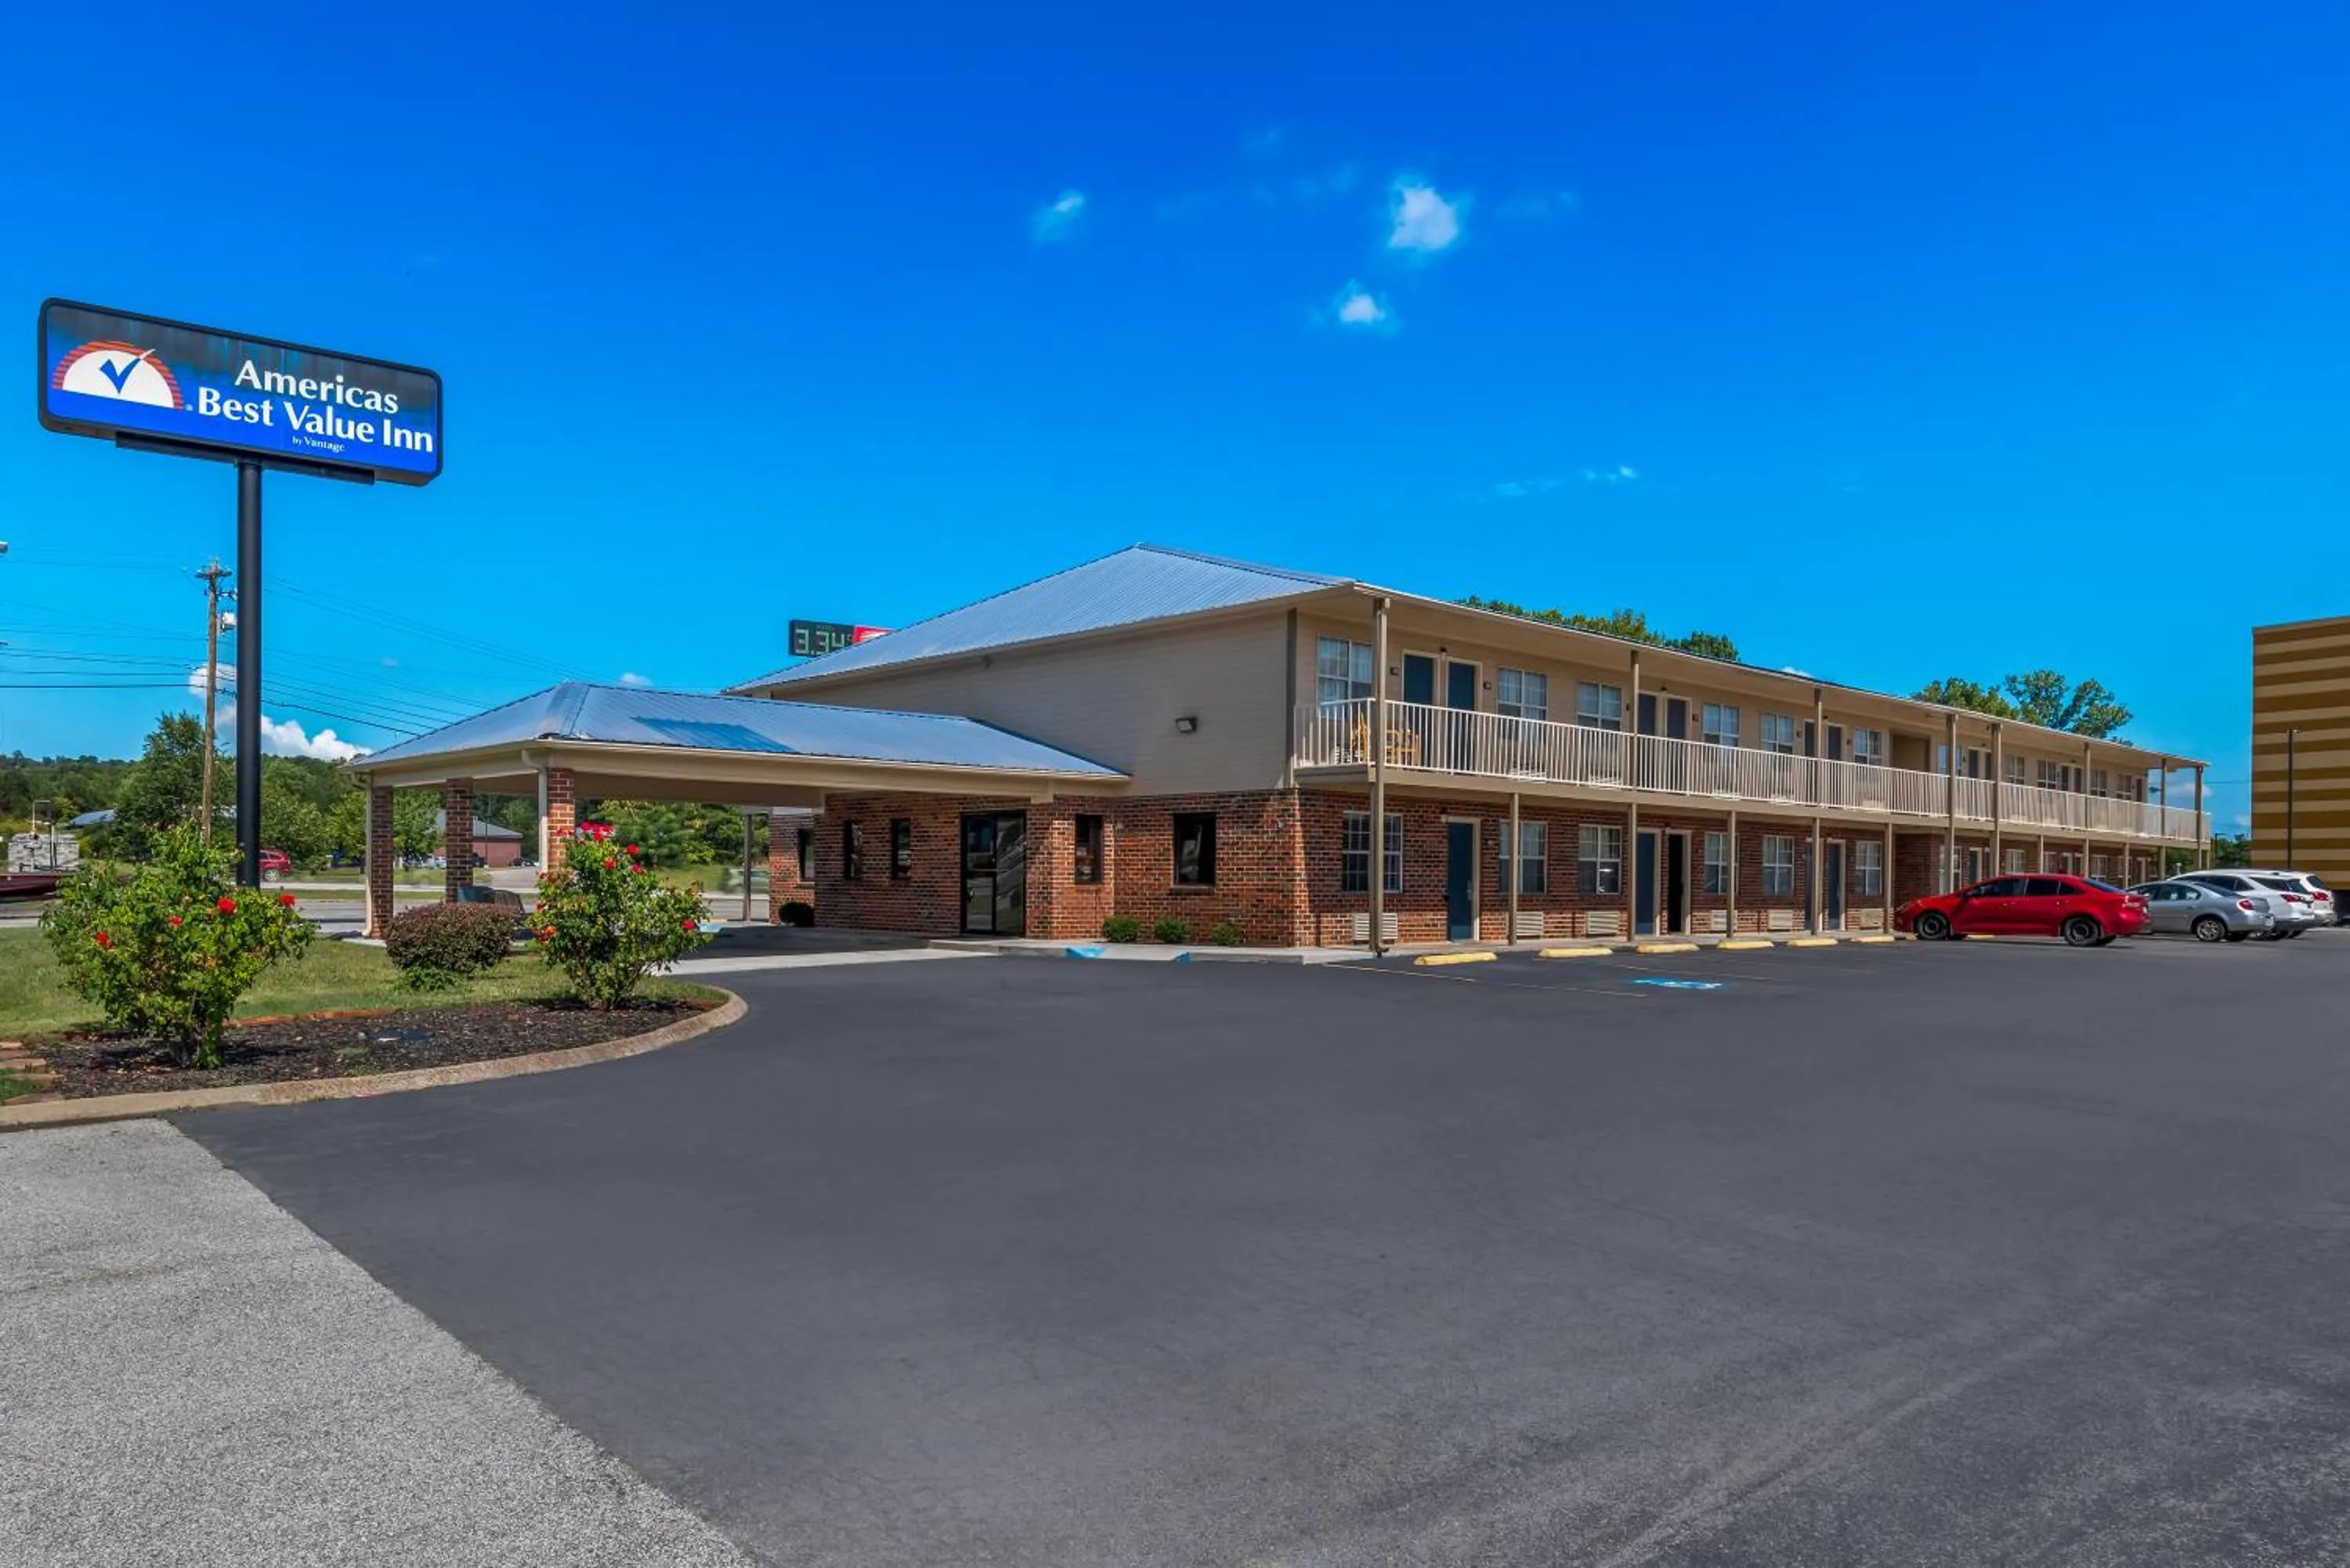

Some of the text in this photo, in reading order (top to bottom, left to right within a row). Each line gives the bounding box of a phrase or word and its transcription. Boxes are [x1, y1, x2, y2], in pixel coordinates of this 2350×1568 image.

[234, 359, 399, 414] Americas
[198, 386, 433, 453] Best Value Inn
[292, 435, 345, 453] by Vantage
